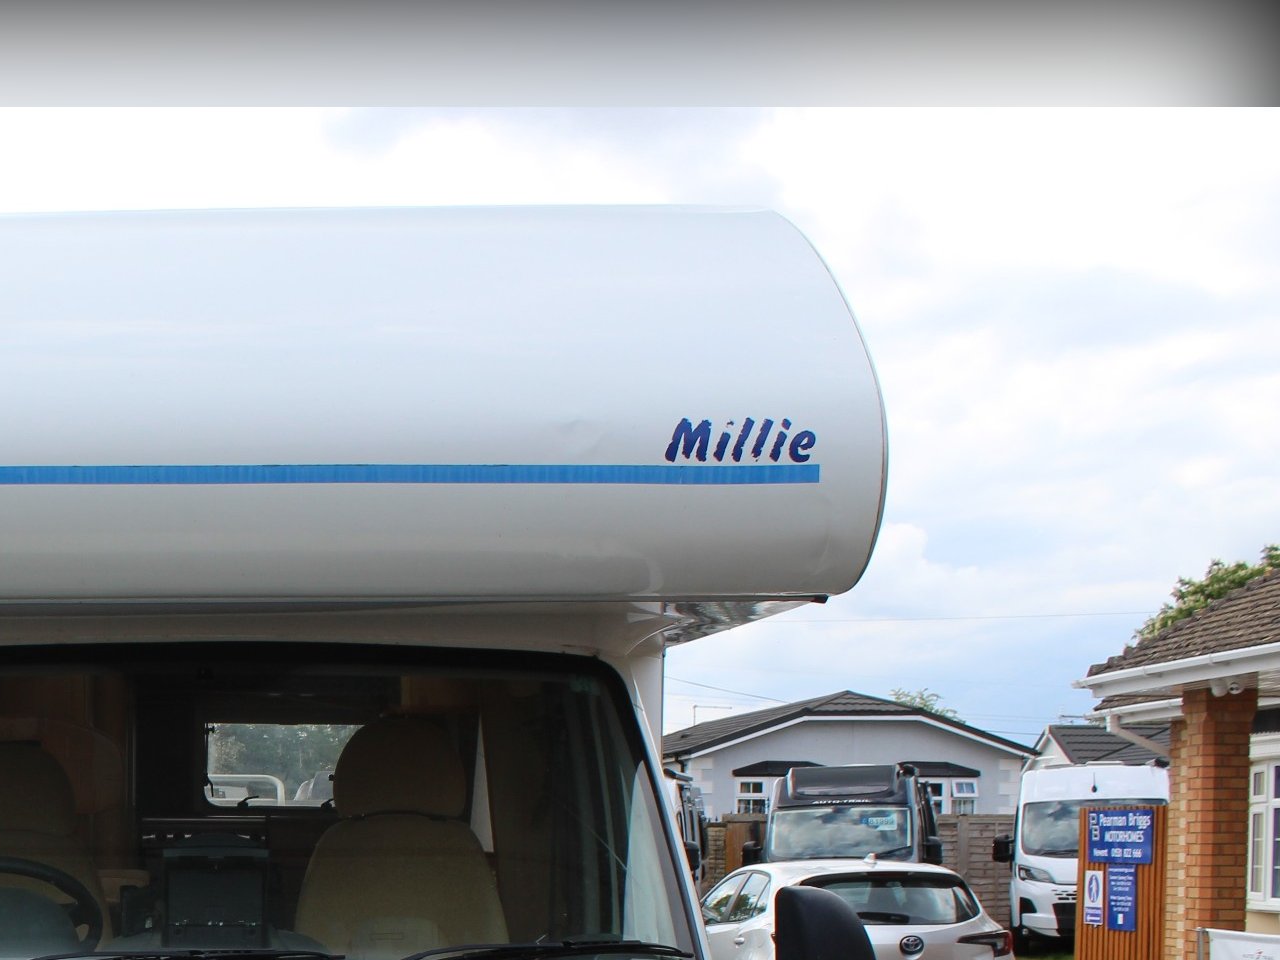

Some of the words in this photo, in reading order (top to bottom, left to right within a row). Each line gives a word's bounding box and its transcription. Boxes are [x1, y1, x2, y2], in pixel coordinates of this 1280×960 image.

[664, 417, 816, 463] Millie
[1099, 813, 1126, 827] Pearman
[1128, 812, 1151, 830] Briggs
